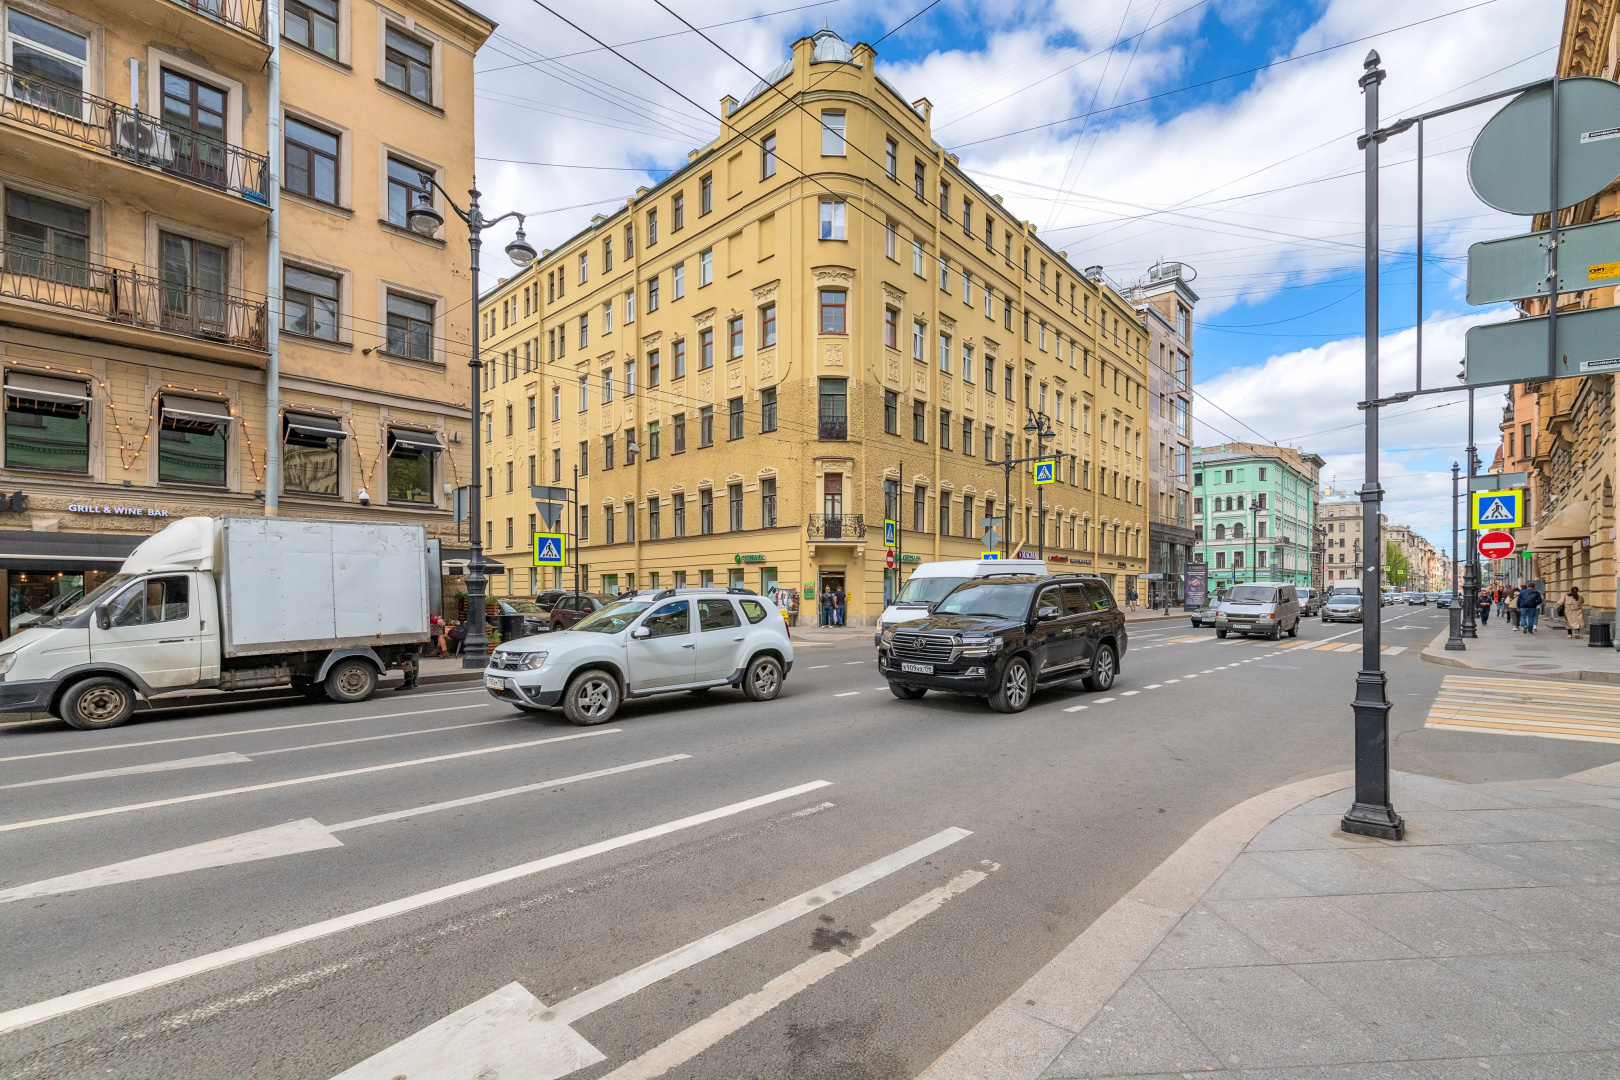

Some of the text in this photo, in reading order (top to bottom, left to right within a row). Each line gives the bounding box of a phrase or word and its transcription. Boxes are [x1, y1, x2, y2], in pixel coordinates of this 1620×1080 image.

[68, 504, 168, 516] GRILL & WINE BAR
